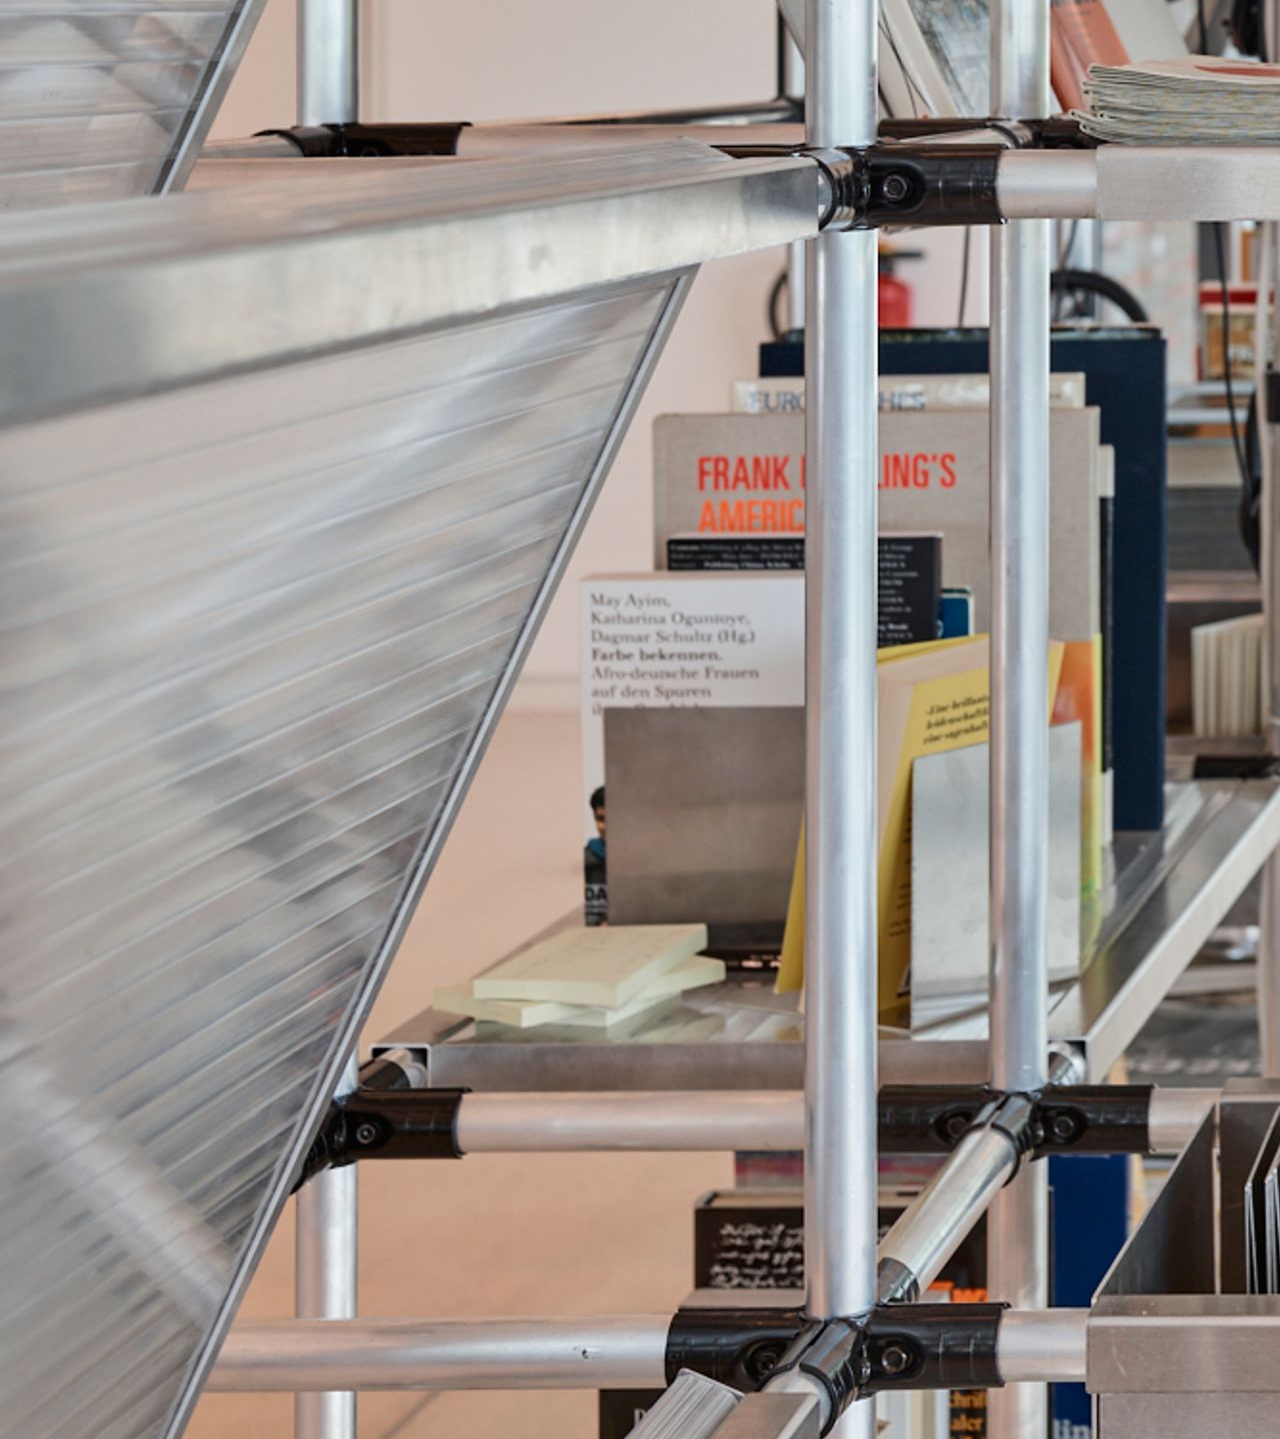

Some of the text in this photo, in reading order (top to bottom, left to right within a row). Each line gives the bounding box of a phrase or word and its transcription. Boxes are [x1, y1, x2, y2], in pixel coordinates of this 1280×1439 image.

[697, 454, 791, 492] FRANK
[698, 497, 806, 533] AMERIC
[590, 593, 672, 609] May Ayim,
[591, 611, 751, 628] Katharina Oguntoye,
[591, 629, 756, 645] Dagmar Schultz (Hg.)
[591, 648, 724, 662] Farbe bekennen.
[591, 666, 760, 681] Afro-deutsche Frauen
[591, 685, 712, 701] auf den Spuren
[951, 694, 989, 711] brillant
[945, 720, 989, 739] sagenhaft
